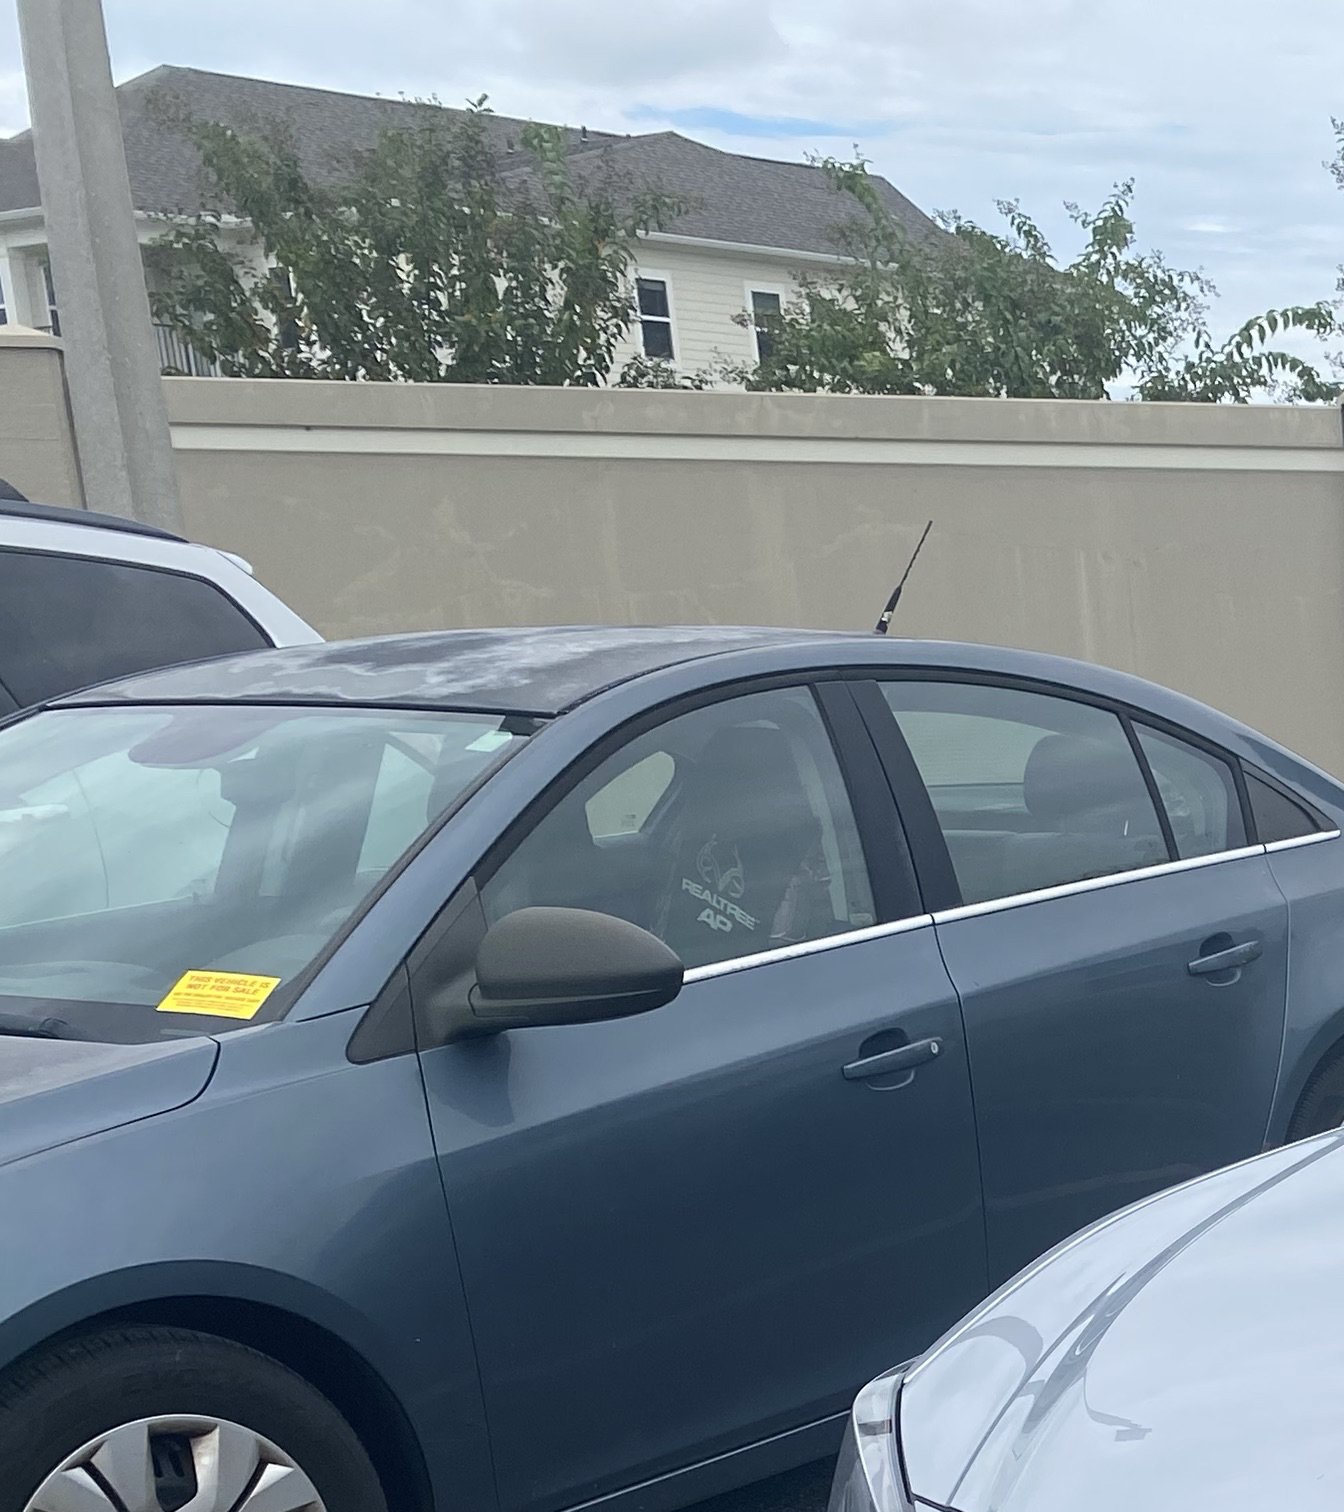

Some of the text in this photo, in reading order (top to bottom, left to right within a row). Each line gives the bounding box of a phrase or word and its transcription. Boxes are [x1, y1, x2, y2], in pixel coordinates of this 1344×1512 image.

[681, 878, 757, 931] REALTREE
[697, 907, 733, 933] AP
[189, 975, 213, 983] THIS
[213, 976, 257, 987] VEHICLE
[209, 984, 232, 992] FOR
[232, 986, 260, 996] SALE
